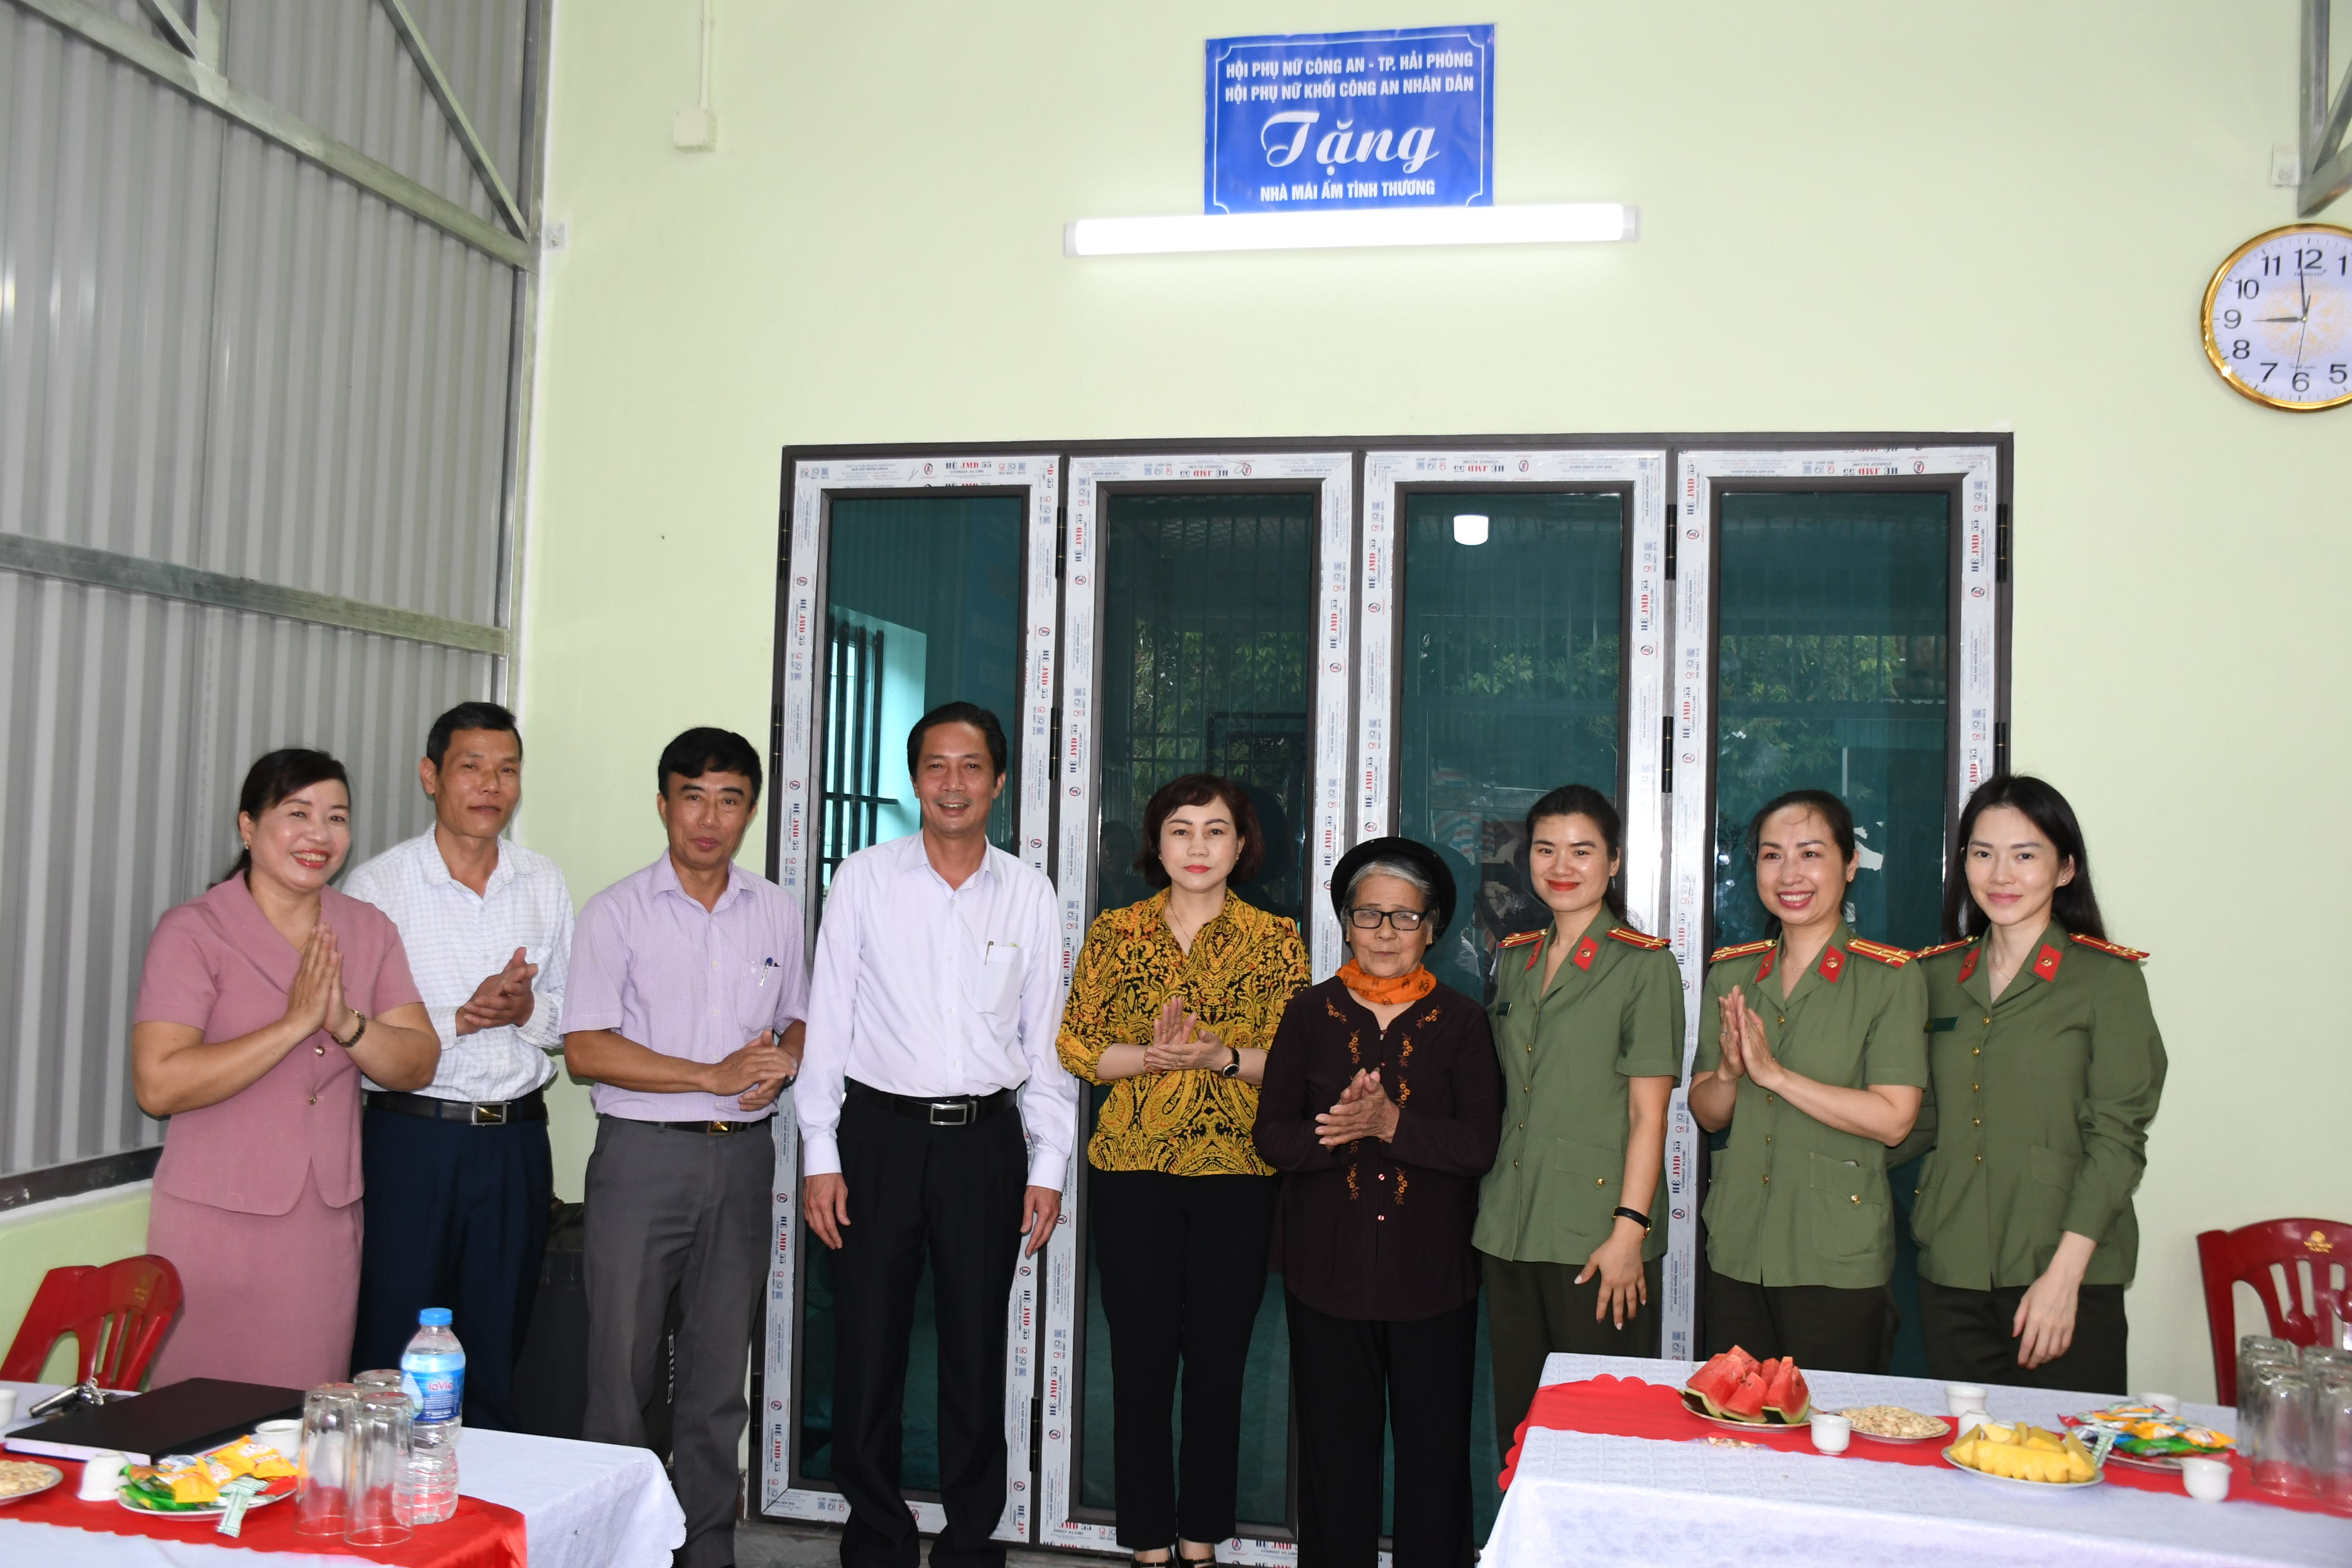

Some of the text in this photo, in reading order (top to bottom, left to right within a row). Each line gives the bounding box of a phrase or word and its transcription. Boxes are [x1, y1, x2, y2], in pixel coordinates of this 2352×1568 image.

[1227, 61, 1248, 81] HỘI
[1253, 61, 1276, 79] PHỤ
[1283, 59, 1302, 76] NỮ
[1306, 57, 1342, 75] CÔNG
[1346, 57, 1365, 72] AN
[1378, 56, 1396, 71] TP.
[1400, 51, 1422, 70] HẢI
[1427, 50, 1473, 69] PHÒNG
[1226, 74, 1473, 104] HỘI PHỤ NỮ KHỐI CÔNG AN NHÂN DÂN
[1260, 112, 1440, 176] Tặng
[1260, 180, 1435, 201] NHÀ MÁI ẤM TÌNH THƯƠNG
[2295, 249, 2322, 269] 12
[2262, 256, 2280, 276] 11
[2338, 256, 2346, 276] 1
[2235, 279, 2259, 299] 10
[2224, 310, 2241, 329] 9
[2232, 340, 2249, 359] 8
[2260, 363, 2278, 382] 7
[2329, 364, 2347, 384] 5
[2292, 372, 2309, 392] 6
[1687, 464, 1694, 475] 55
[1076, 514, 1082, 524] 55
[1971, 520, 1979, 531] 55
[1369, 540, 1375, 550] 55
[1641, 580, 1648, 591] 55
[1331, 599, 1337, 610] 55
[799, 635, 805, 645] 55
[1041, 688, 1048, 698] 55
[1683, 687, 1690, 698] 55
[1071, 724, 1077, 734] 55
[1366, 757, 1373, 768] 55
[1325, 816, 1331, 826] 55
[792, 840, 799, 850] 55
[1678, 913, 1685, 924] 55
[1064, 937, 1070, 947] 55
[1673, 1141, 1681, 1152] 55
[779, 1253, 786, 1264] 55
[1023, 1329, 1030, 1339] 55
[1051, 1366, 1057, 1377] 55
[775, 1461, 781, 1472] 55
